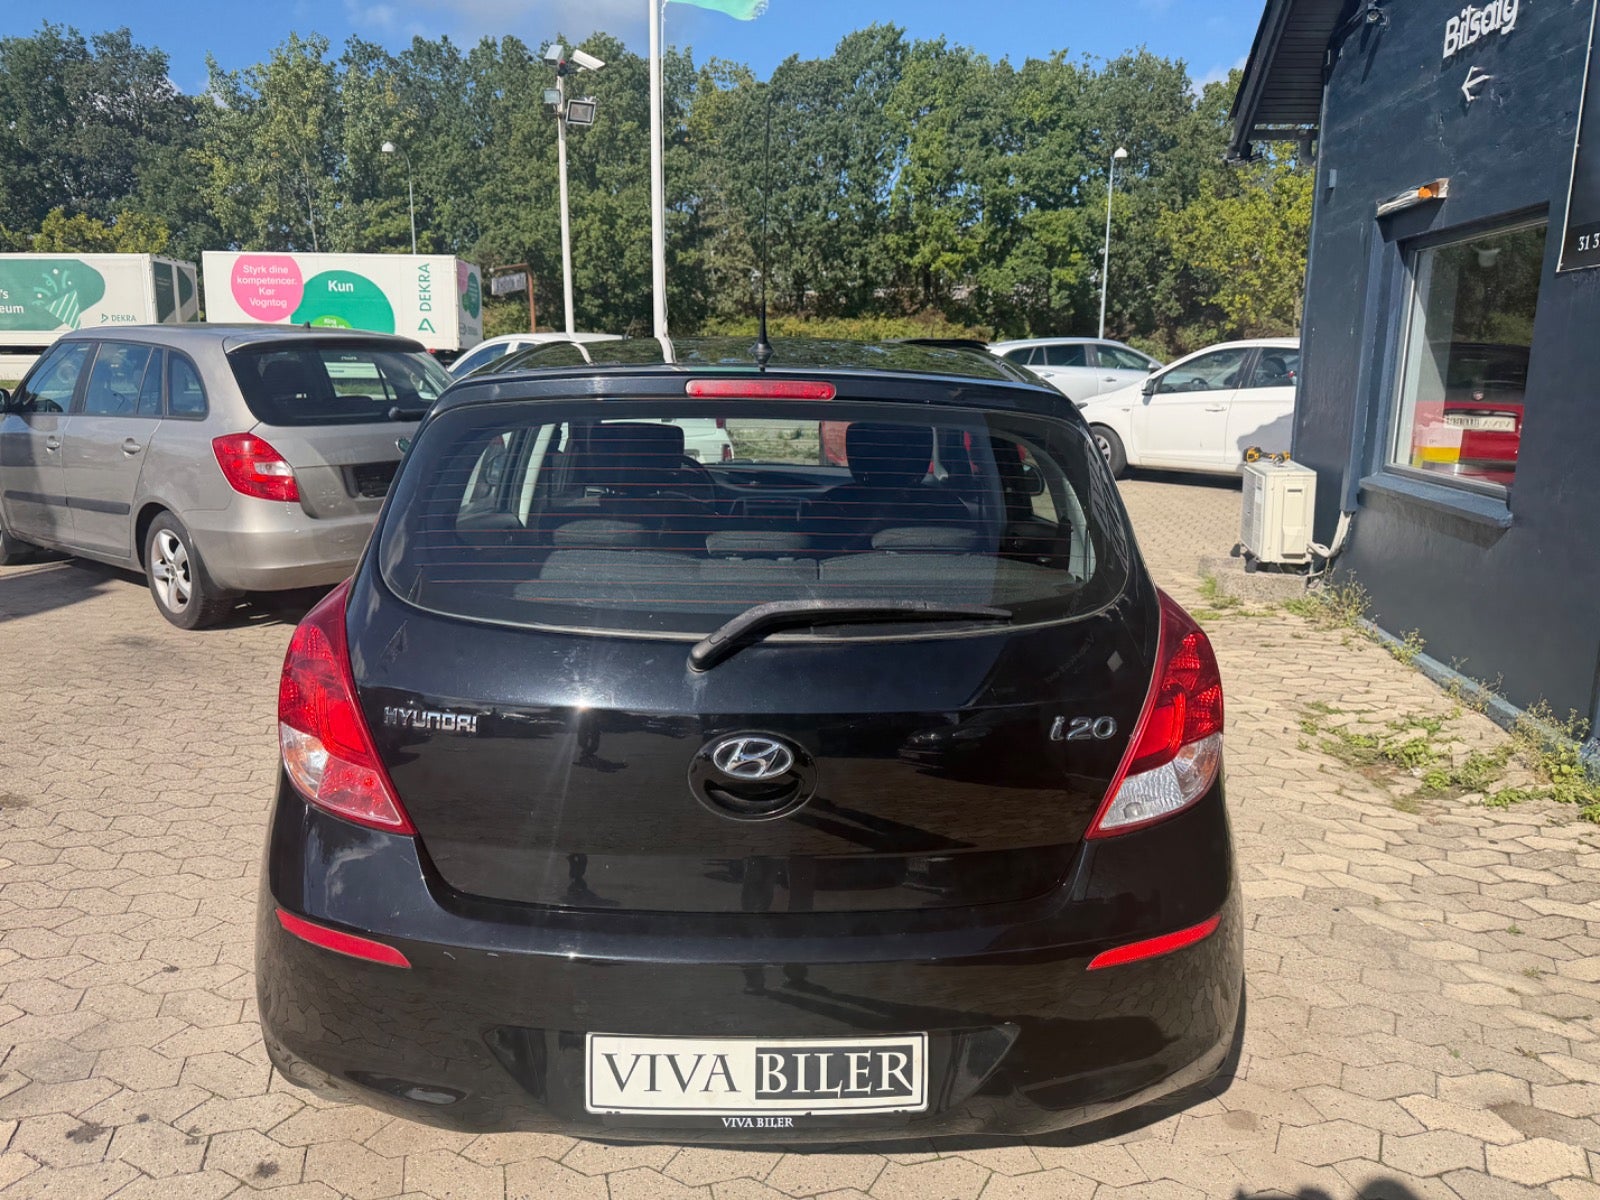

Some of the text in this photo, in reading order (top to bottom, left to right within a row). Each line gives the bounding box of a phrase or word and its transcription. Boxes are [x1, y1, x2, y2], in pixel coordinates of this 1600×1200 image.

[1443, 0, 1518, 59] Bilsalg
[1578, 232, 1600, 251] 31 3
[243, 265, 289, 275] Styrk dine
[237, 276, 298, 286] kompetencer.
[328, 279, 354, 292] Kun
[417, 263, 432, 311] DEKRA
[249, 297, 288, 309] Vogntog
[111, 314, 137, 322] DEKRA
[384, 706, 477, 733] HYUNDAI
[1050, 716, 1117, 741] i20
[601, 1050, 913, 1099] VIVA BILER
[721, 1117, 794, 1128] VIVA BILER
